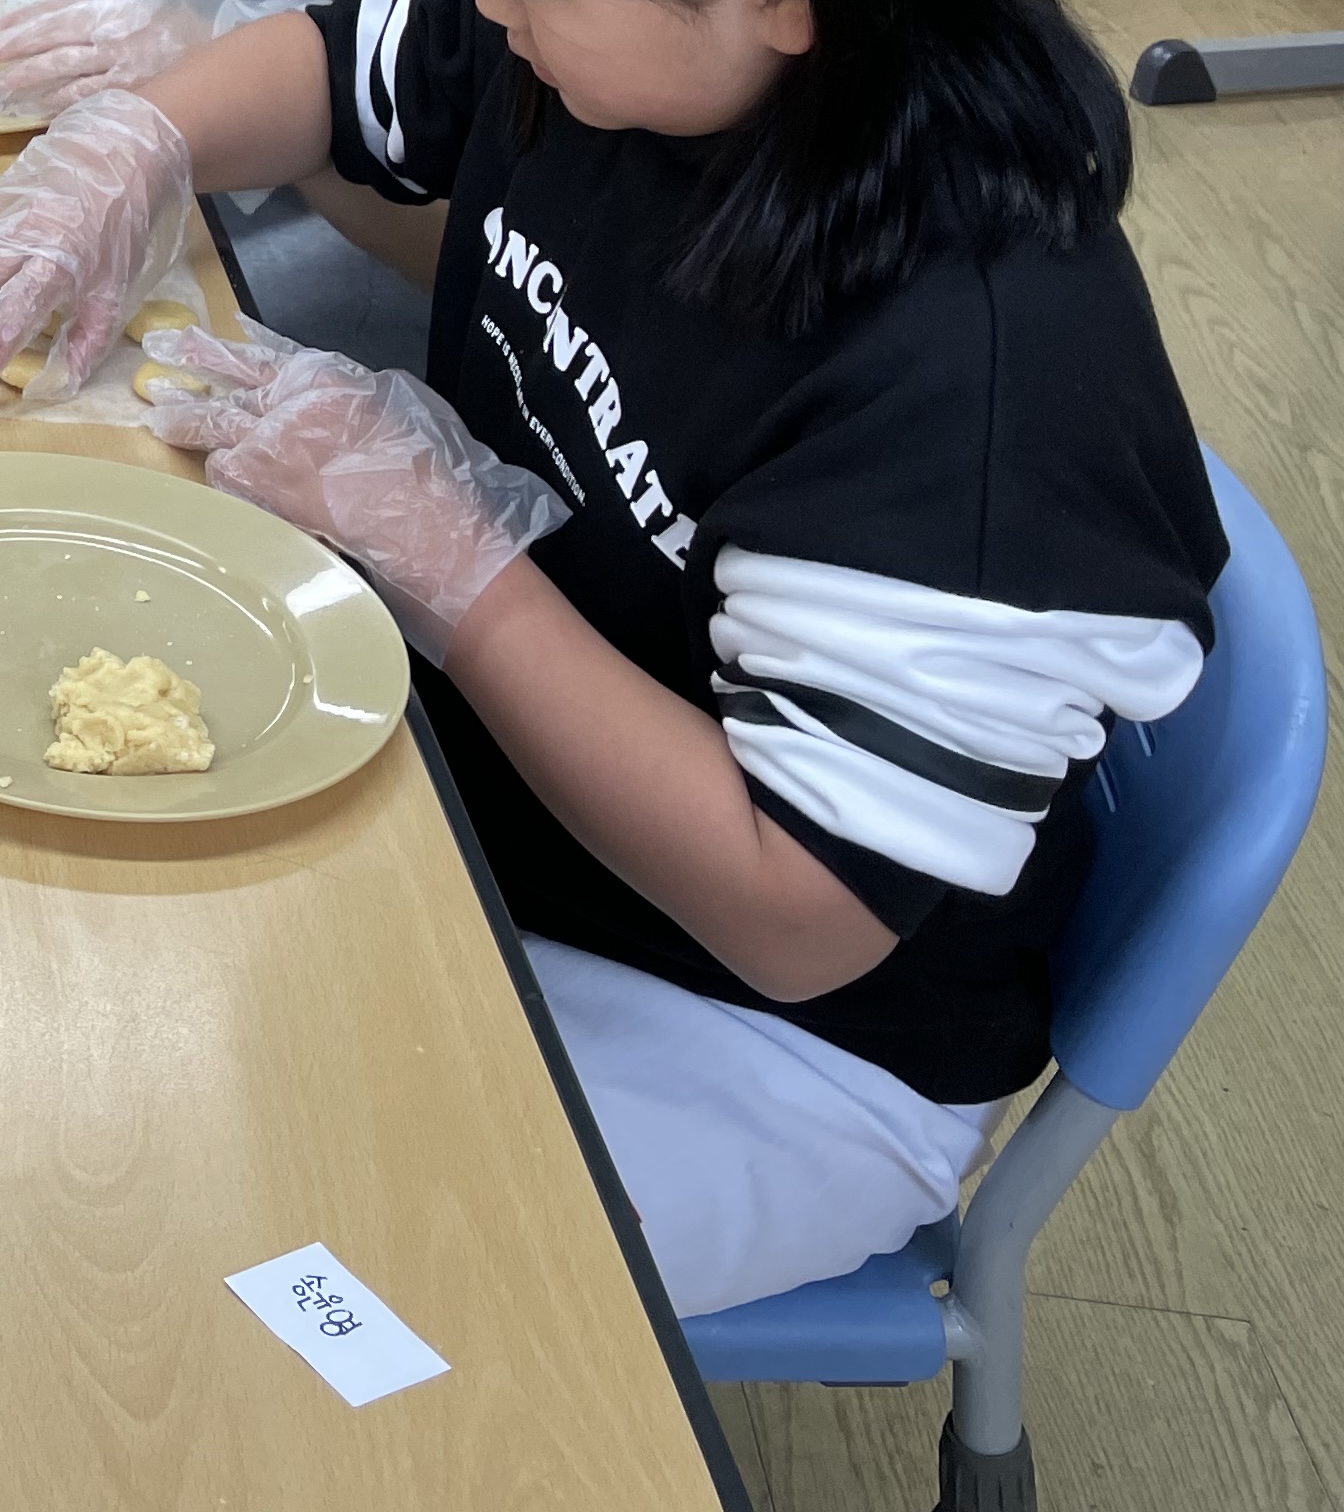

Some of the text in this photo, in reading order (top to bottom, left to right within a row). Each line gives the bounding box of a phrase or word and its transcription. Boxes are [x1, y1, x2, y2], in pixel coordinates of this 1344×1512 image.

[481, 314, 506, 346] HOPE
[502, 340, 511, 357] IS
[529, 415, 555, 452] EVERY
[551, 446, 586, 507] CONDITION.
[291, 1274, 362, 1337] 송윤영
